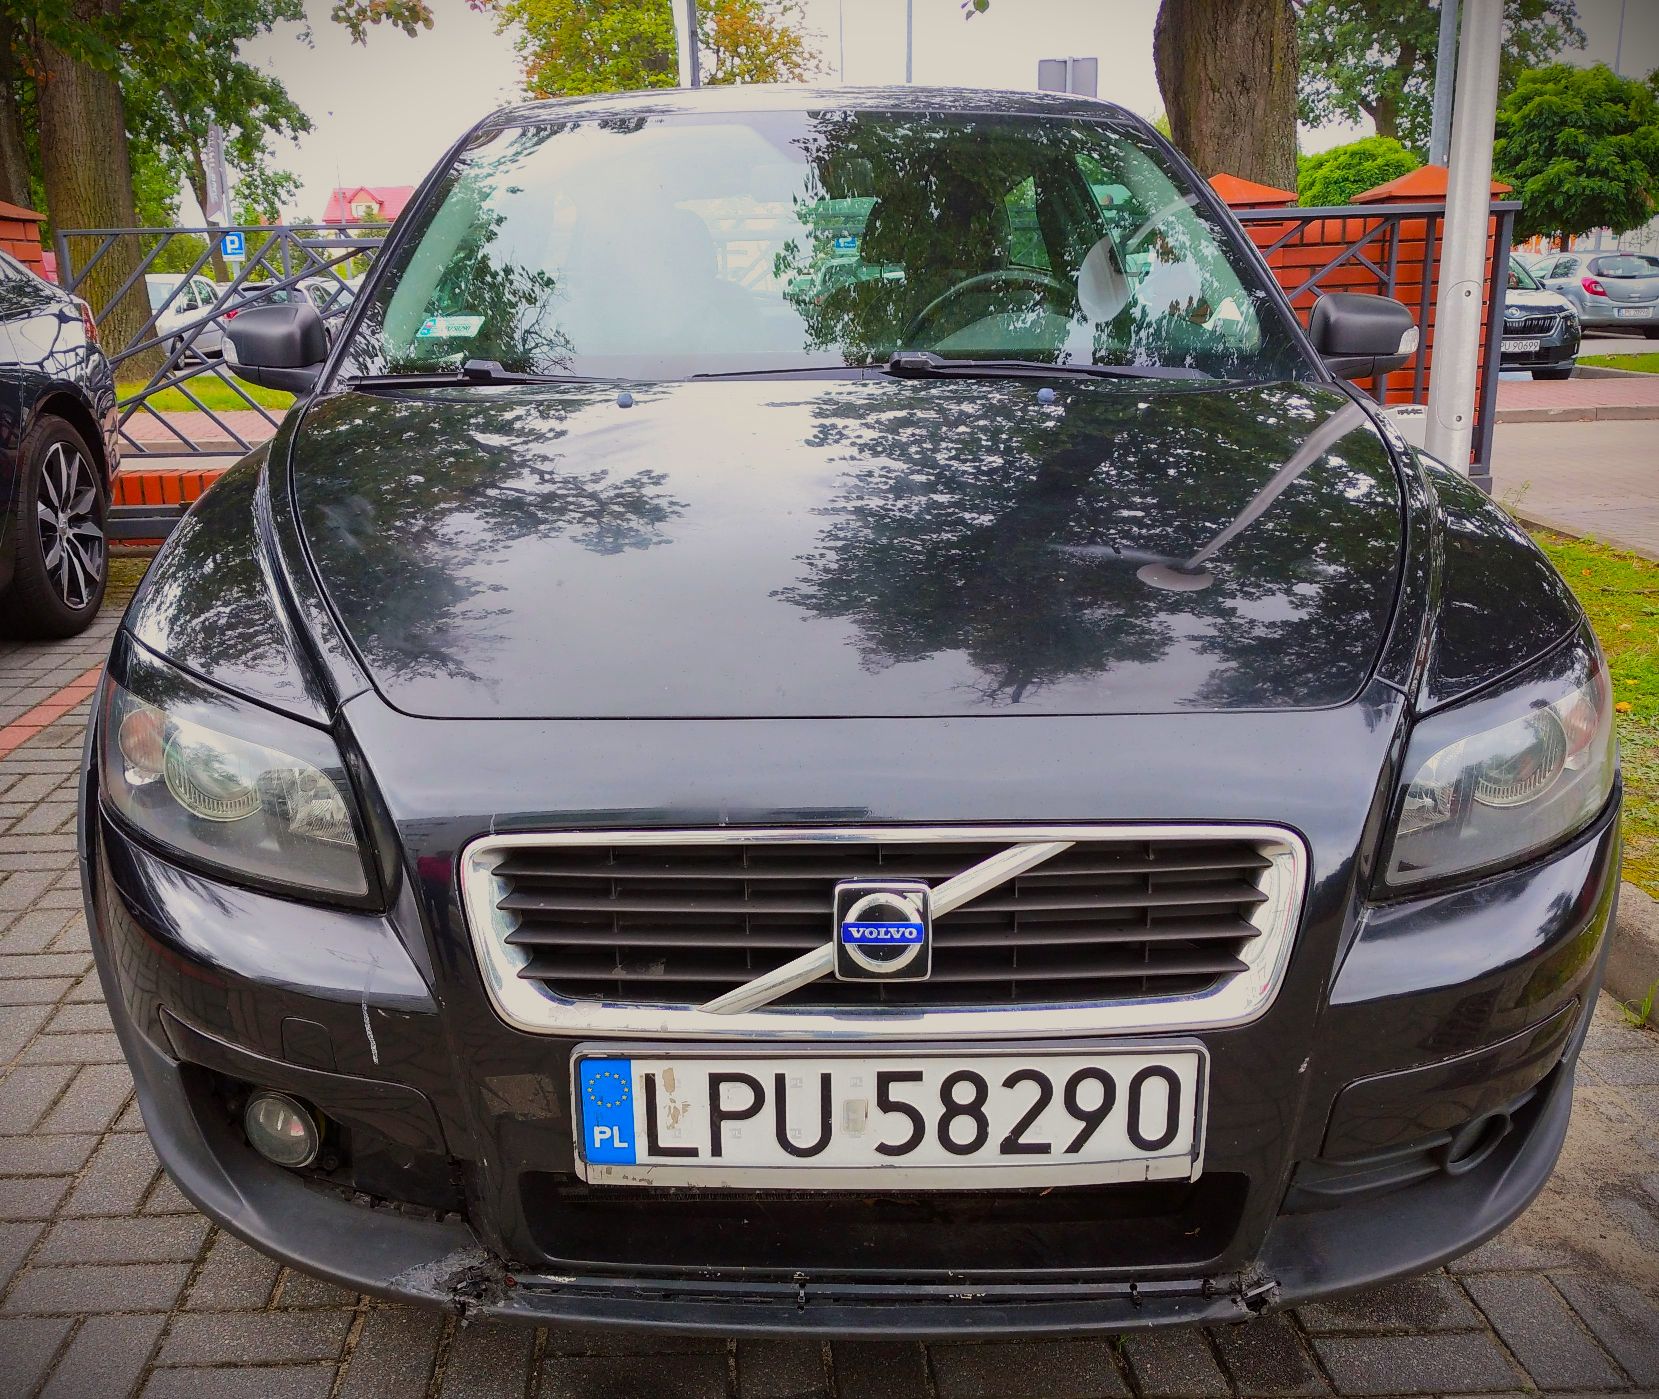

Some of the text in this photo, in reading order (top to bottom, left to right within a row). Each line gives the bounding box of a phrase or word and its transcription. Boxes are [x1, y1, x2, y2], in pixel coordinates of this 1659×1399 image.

[225, 235, 239, 254] P
[1512, 341, 1539, 351] 90699
[848, 927, 918, 939] VOLVO
[644, 1065, 1183, 1158] LPU 58290
[593, 1125, 629, 1149] PL
